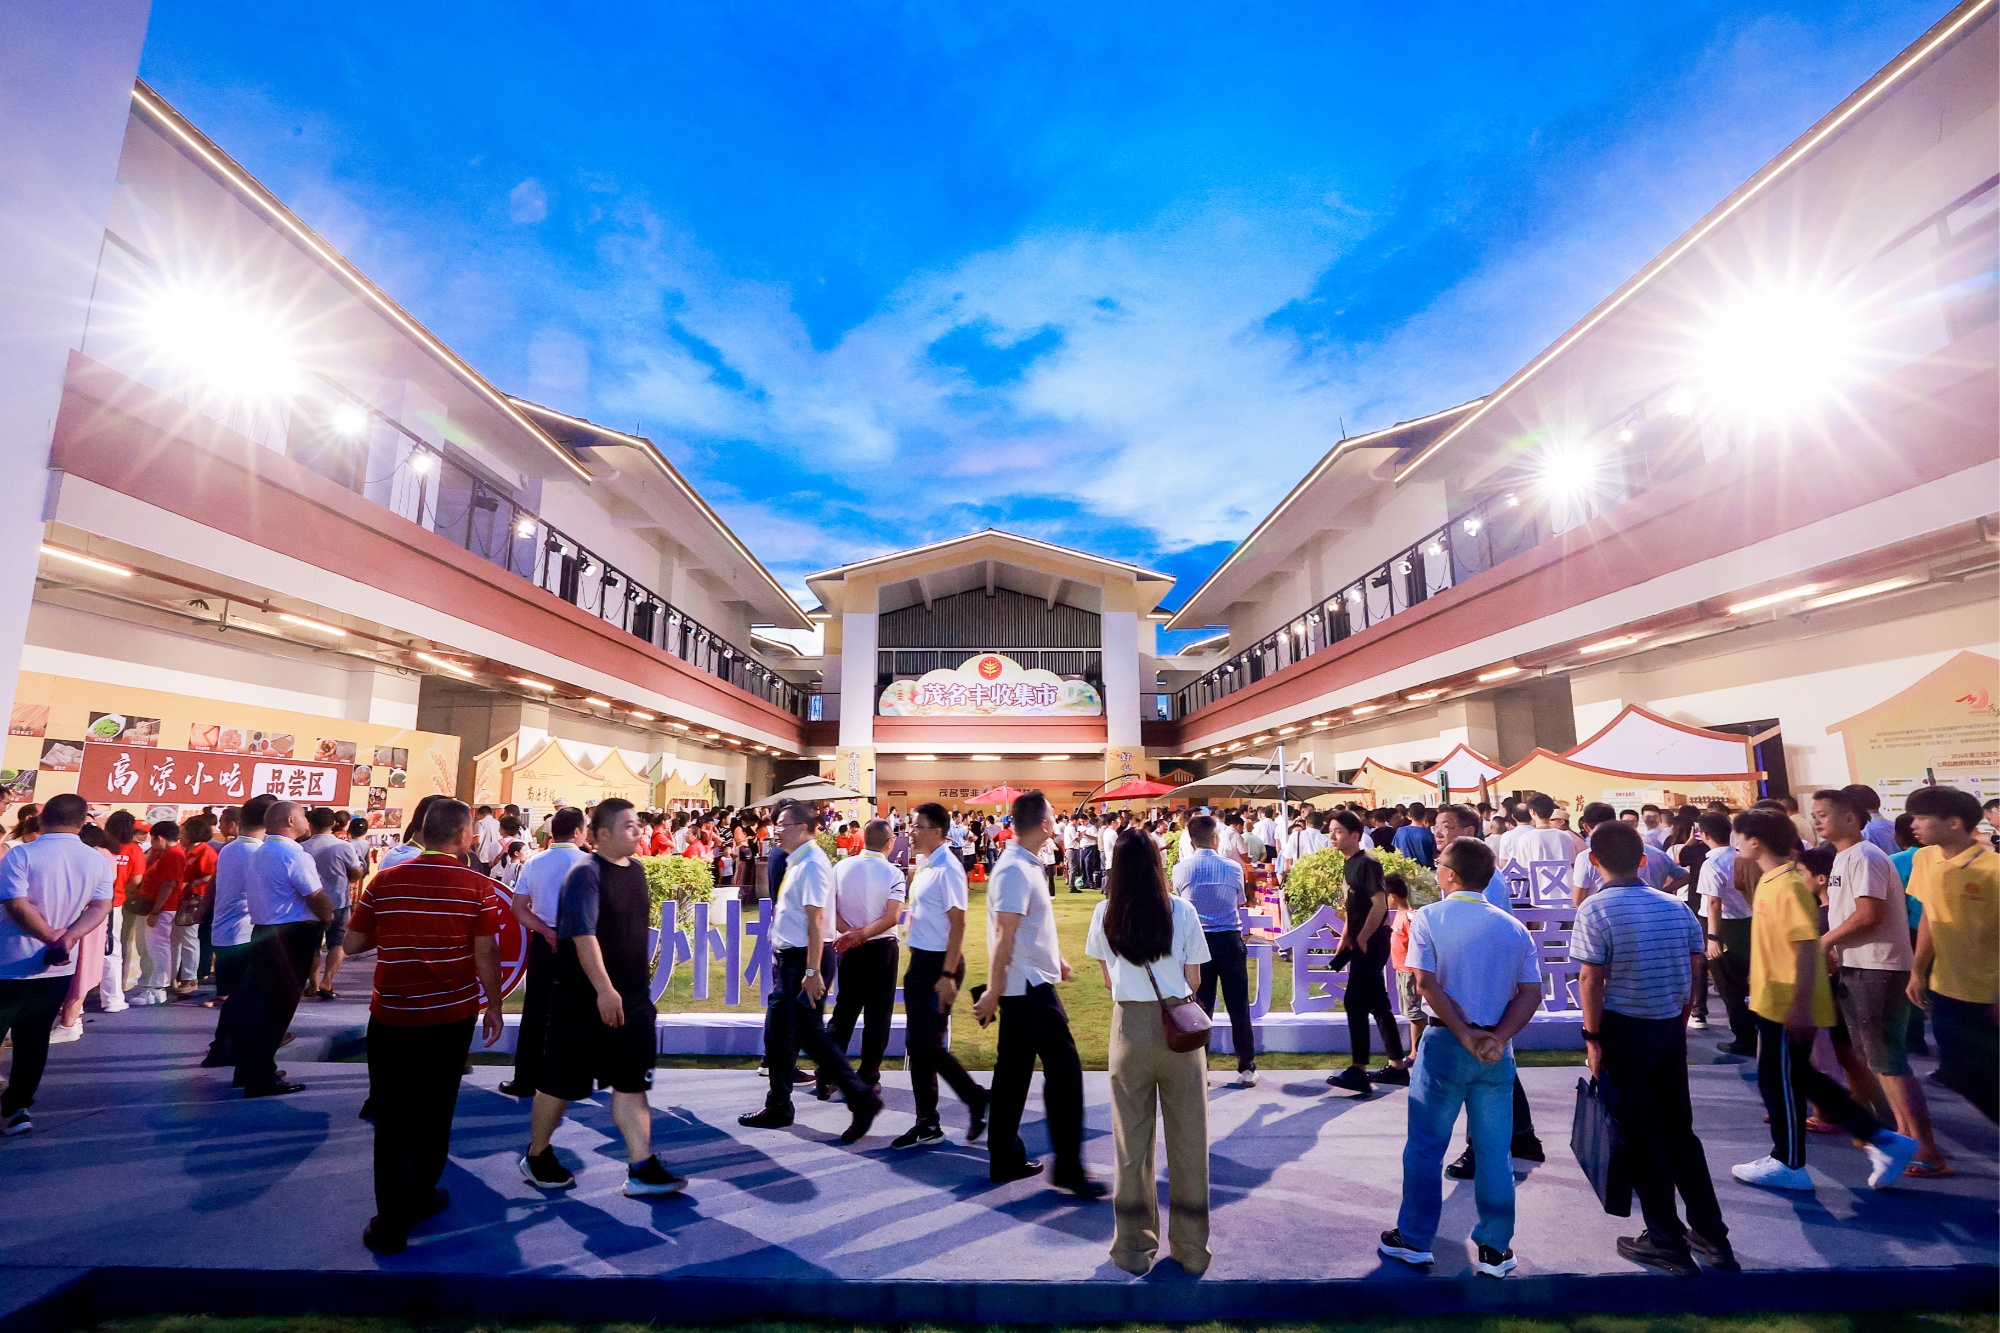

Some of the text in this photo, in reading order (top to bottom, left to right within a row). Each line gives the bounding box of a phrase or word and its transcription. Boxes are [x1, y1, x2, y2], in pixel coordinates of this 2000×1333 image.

[921, 683, 1058, 707] 茂名丰收集市
[107, 752, 245, 798] 高凉小吃
[266, 768, 324, 797] 品尝区
